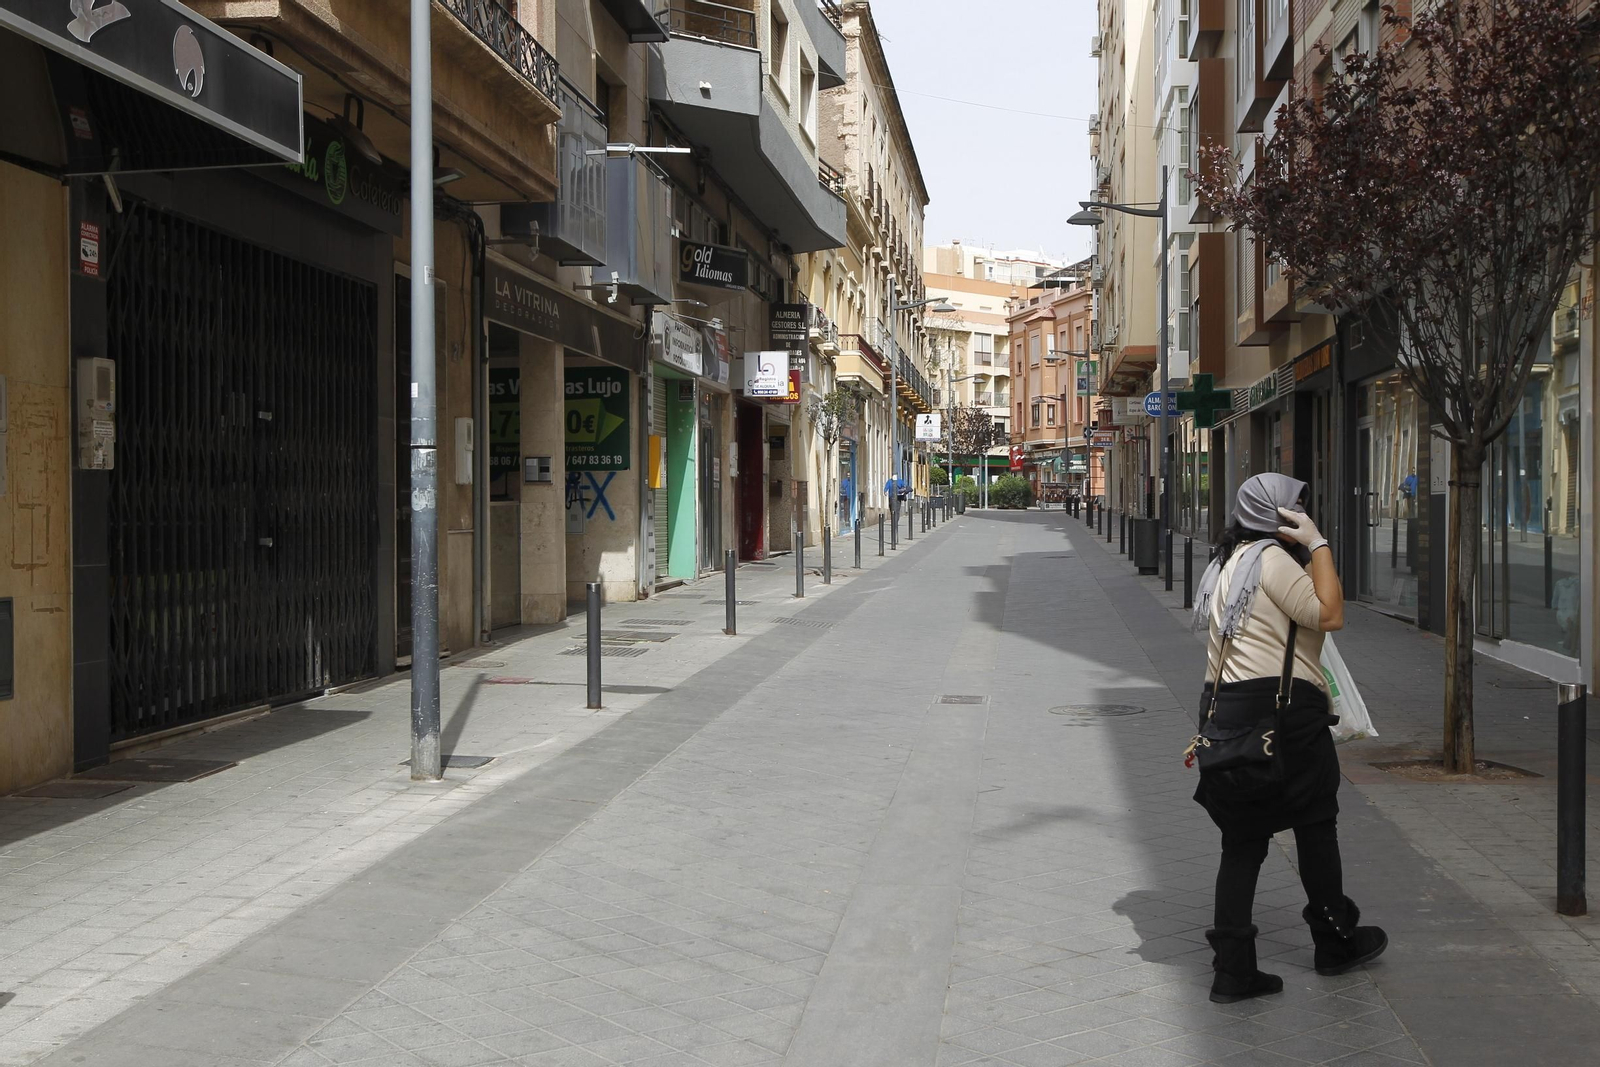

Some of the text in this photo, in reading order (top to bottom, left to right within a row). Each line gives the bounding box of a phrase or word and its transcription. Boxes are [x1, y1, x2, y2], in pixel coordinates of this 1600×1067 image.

[81, 222, 99, 235] ALARMA
[681, 244, 713, 272] gold
[695, 263, 733, 283] Idiomas
[495, 276, 560, 319] LA VITRINA
[775, 311, 801, 320] ALMERIA
[771, 320, 797, 330] GESTORES
[489, 377, 622, 398] as V as Lujo
[572, 456, 588, 468] 647
[589, 456, 600, 468] 83
[601, 456, 612, 467] 36
[614, 455, 623, 467] 19
